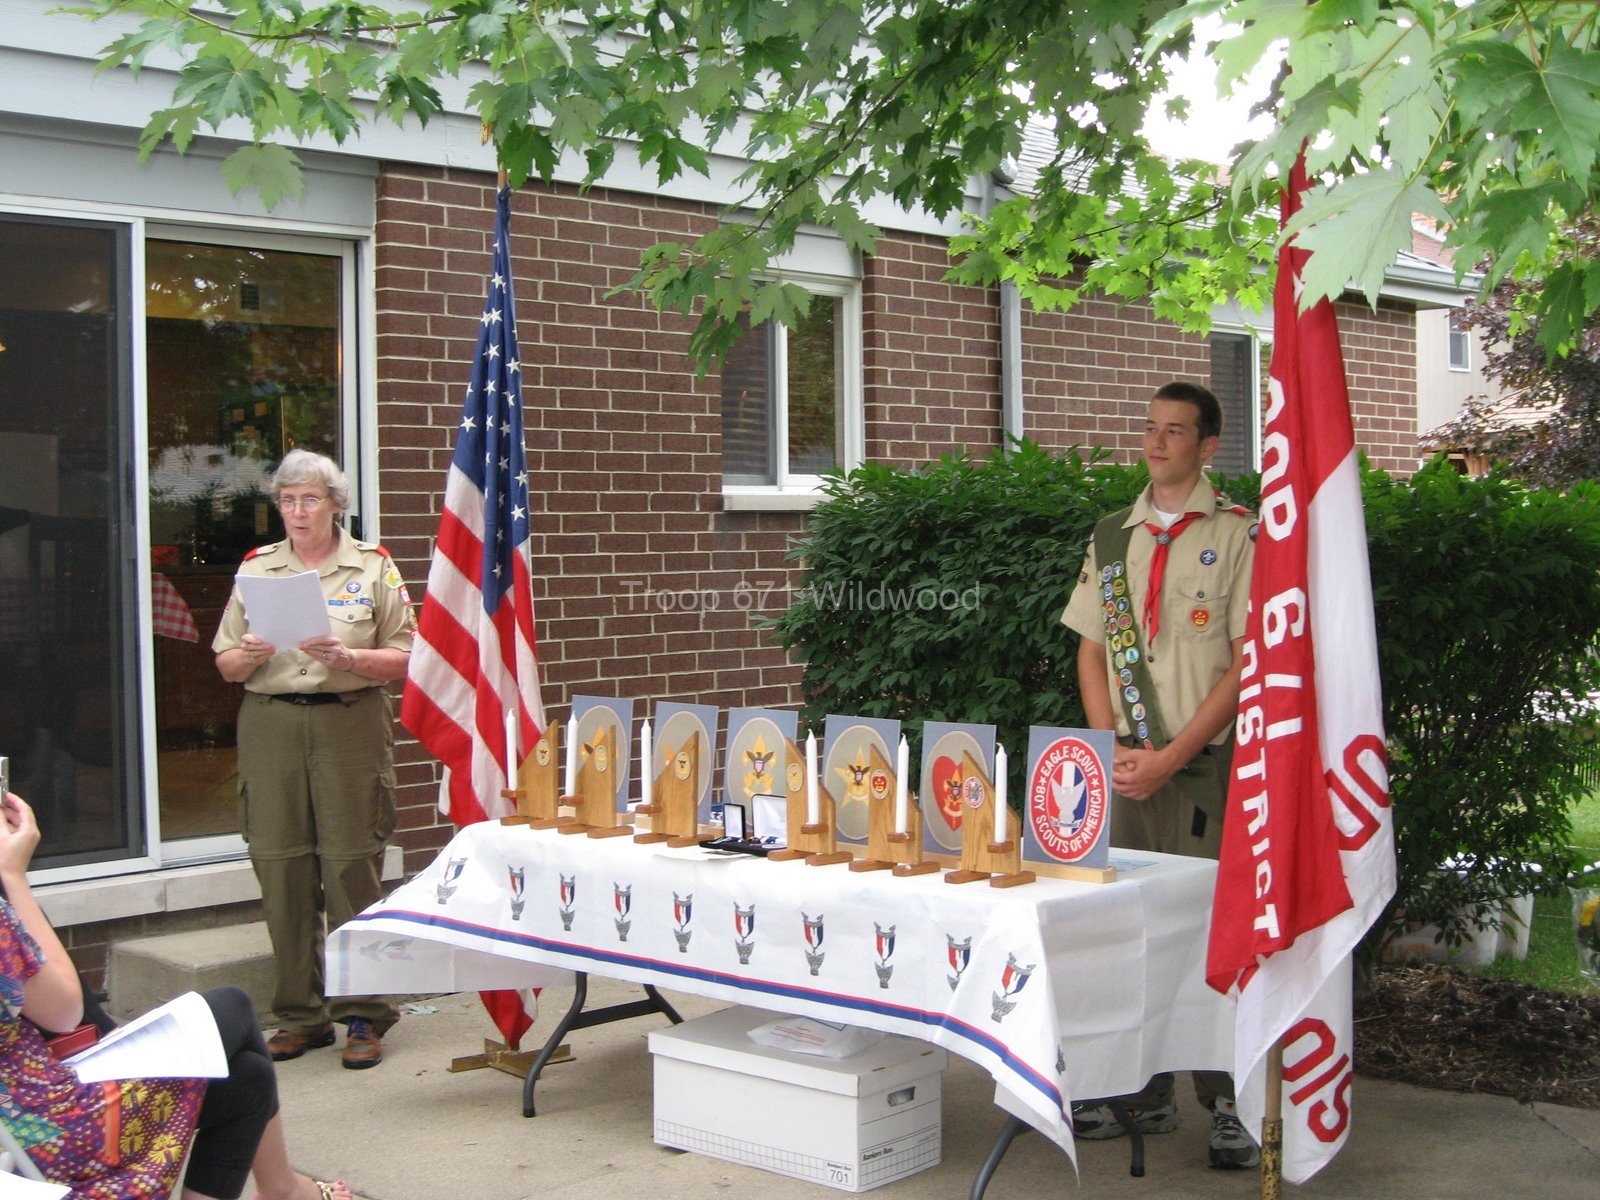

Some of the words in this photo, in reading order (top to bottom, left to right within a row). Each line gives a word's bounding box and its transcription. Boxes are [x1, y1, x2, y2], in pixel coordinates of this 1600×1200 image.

[1040, 745, 1069, 778] EAGLE
[1071, 745, 1099, 778] SCOUT
[1034, 786, 1046, 812] BOY
[1080, 790, 1102, 845] AMERICA
[1036, 816, 1070, 854] SCOUTS
[1069, 838, 1083, 852] OF
[829, 1169, 849, 1184] 701
